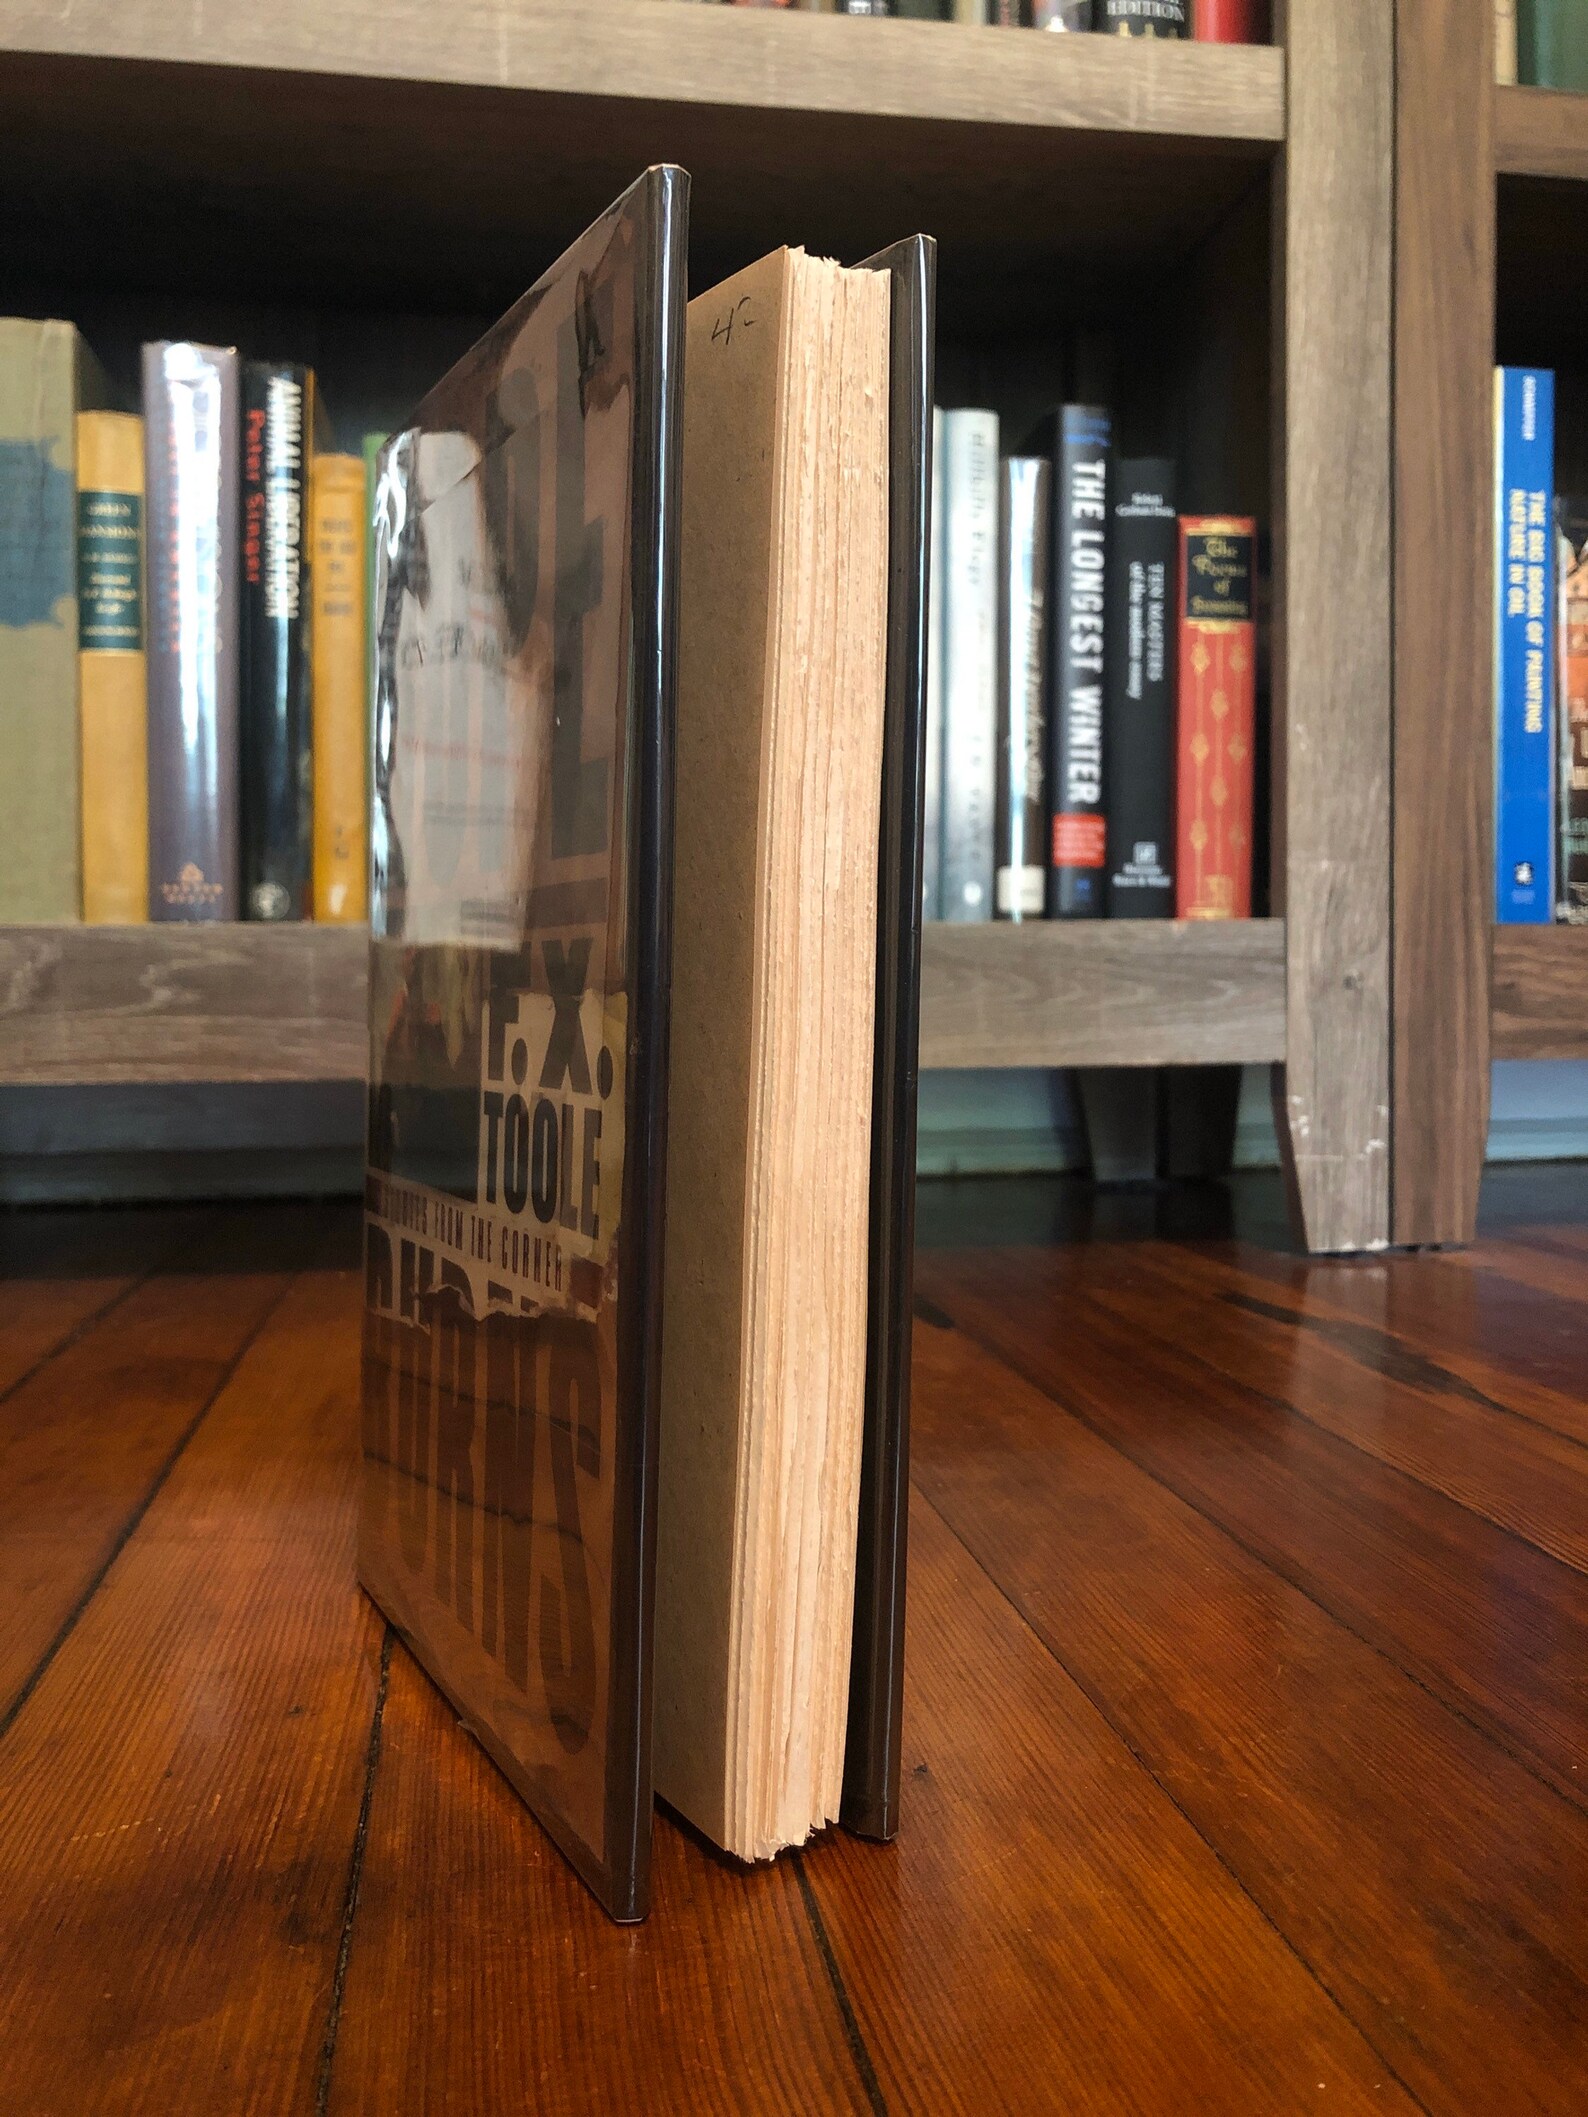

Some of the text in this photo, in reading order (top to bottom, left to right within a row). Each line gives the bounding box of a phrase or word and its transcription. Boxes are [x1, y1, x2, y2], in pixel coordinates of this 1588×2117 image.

[1070, 459, 1106, 521] THE
[1508, 489, 1528, 617] NATURE IN OIL
[1069, 530, 1105, 673] LONGEST
[1524, 489, 1546, 733] THE BIG BOOK OF PAINTING
[1066, 684, 1103, 804] WINTER
[484, 1092, 603, 1241] TOOLE
[434, 1201, 463, 1250] FROM
[471, 1214, 492, 1262] THE
[501, 1225, 562, 1291] CORNER
